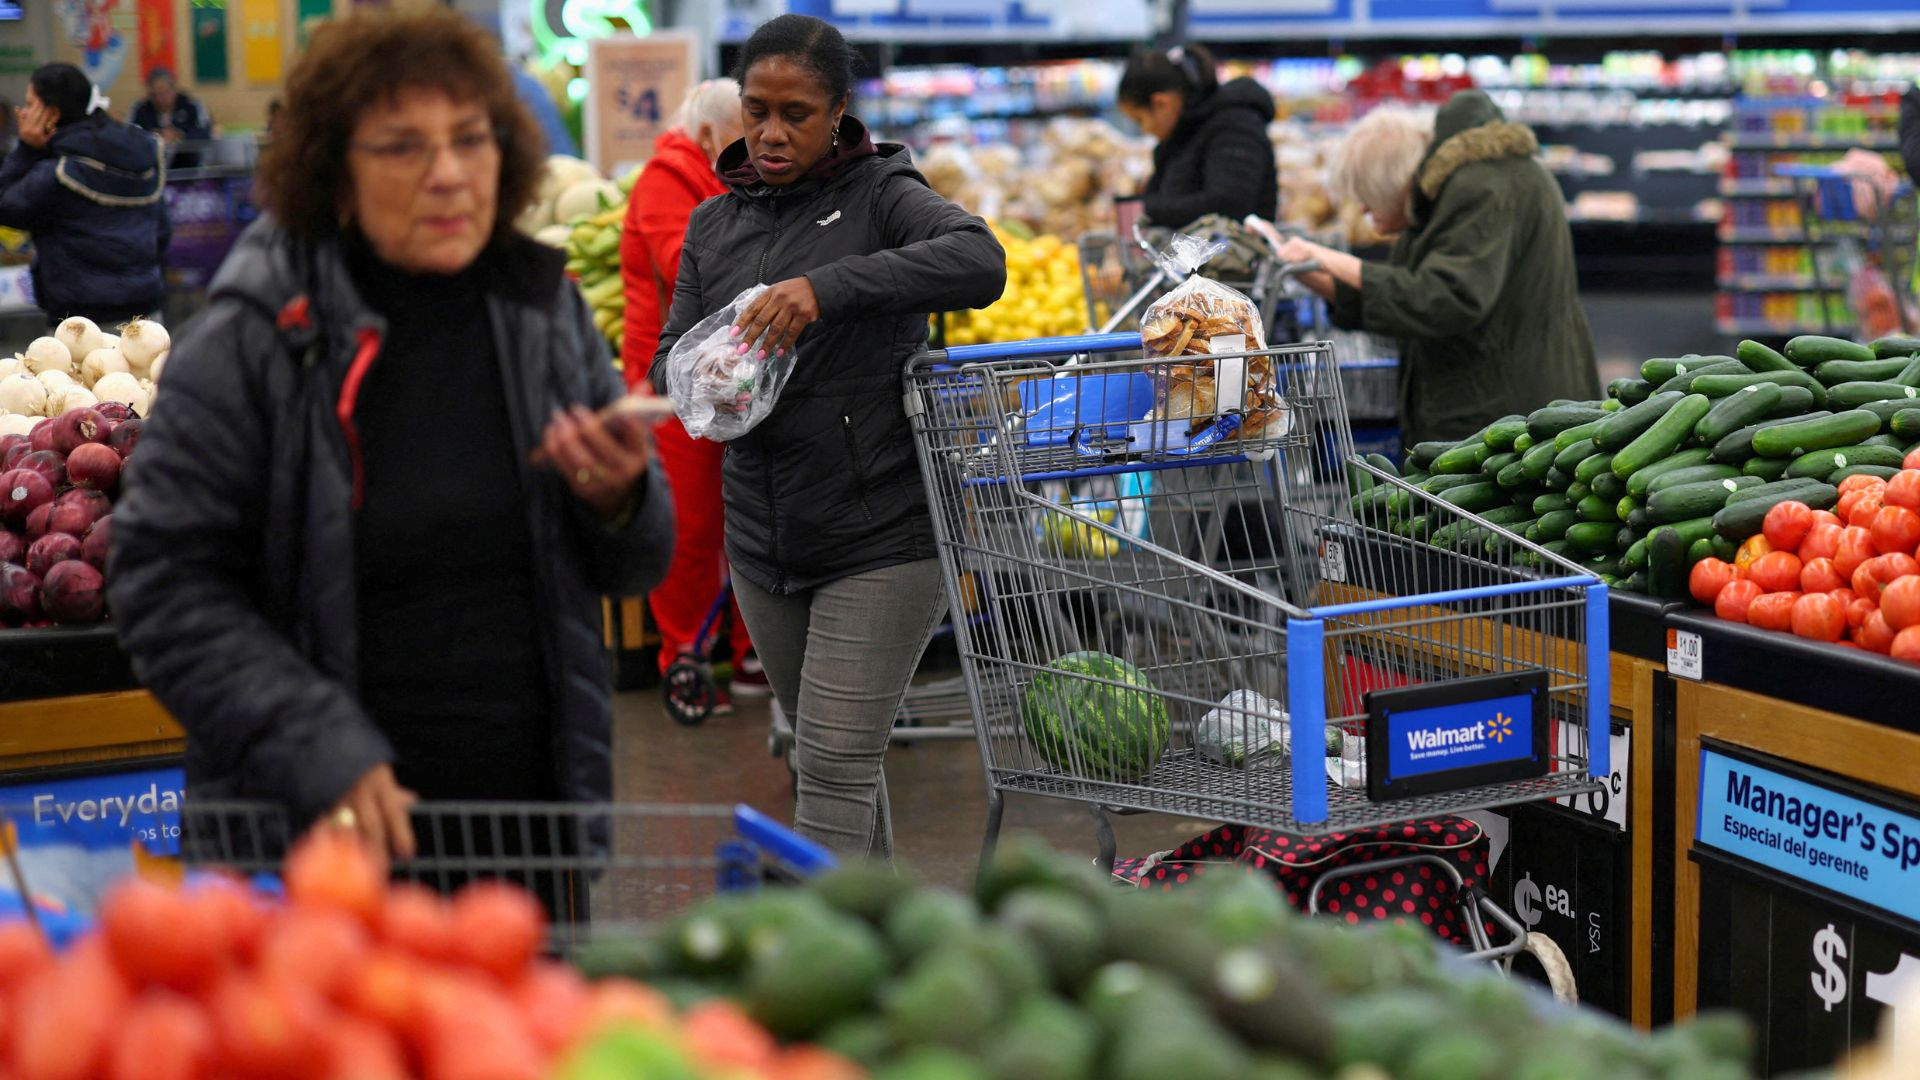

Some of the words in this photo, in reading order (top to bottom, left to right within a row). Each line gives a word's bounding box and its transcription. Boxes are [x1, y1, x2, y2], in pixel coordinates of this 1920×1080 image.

[1407, 721, 1485, 750] Walmart
[1410, 751, 1425, 760] Save
[1426, 747, 1449, 757] money.
[1450, 745, 1463, 754] Live
[1464, 742, 1486, 752] better.
[1726, 769, 1876, 851] Manager's
[1723, 814, 1781, 850] Especial
[1783, 836, 1806, 859] del
[1808, 847, 1869, 881] gerente
[1545, 884, 1576, 919] ea.
[1588, 911, 1601, 953] USA
